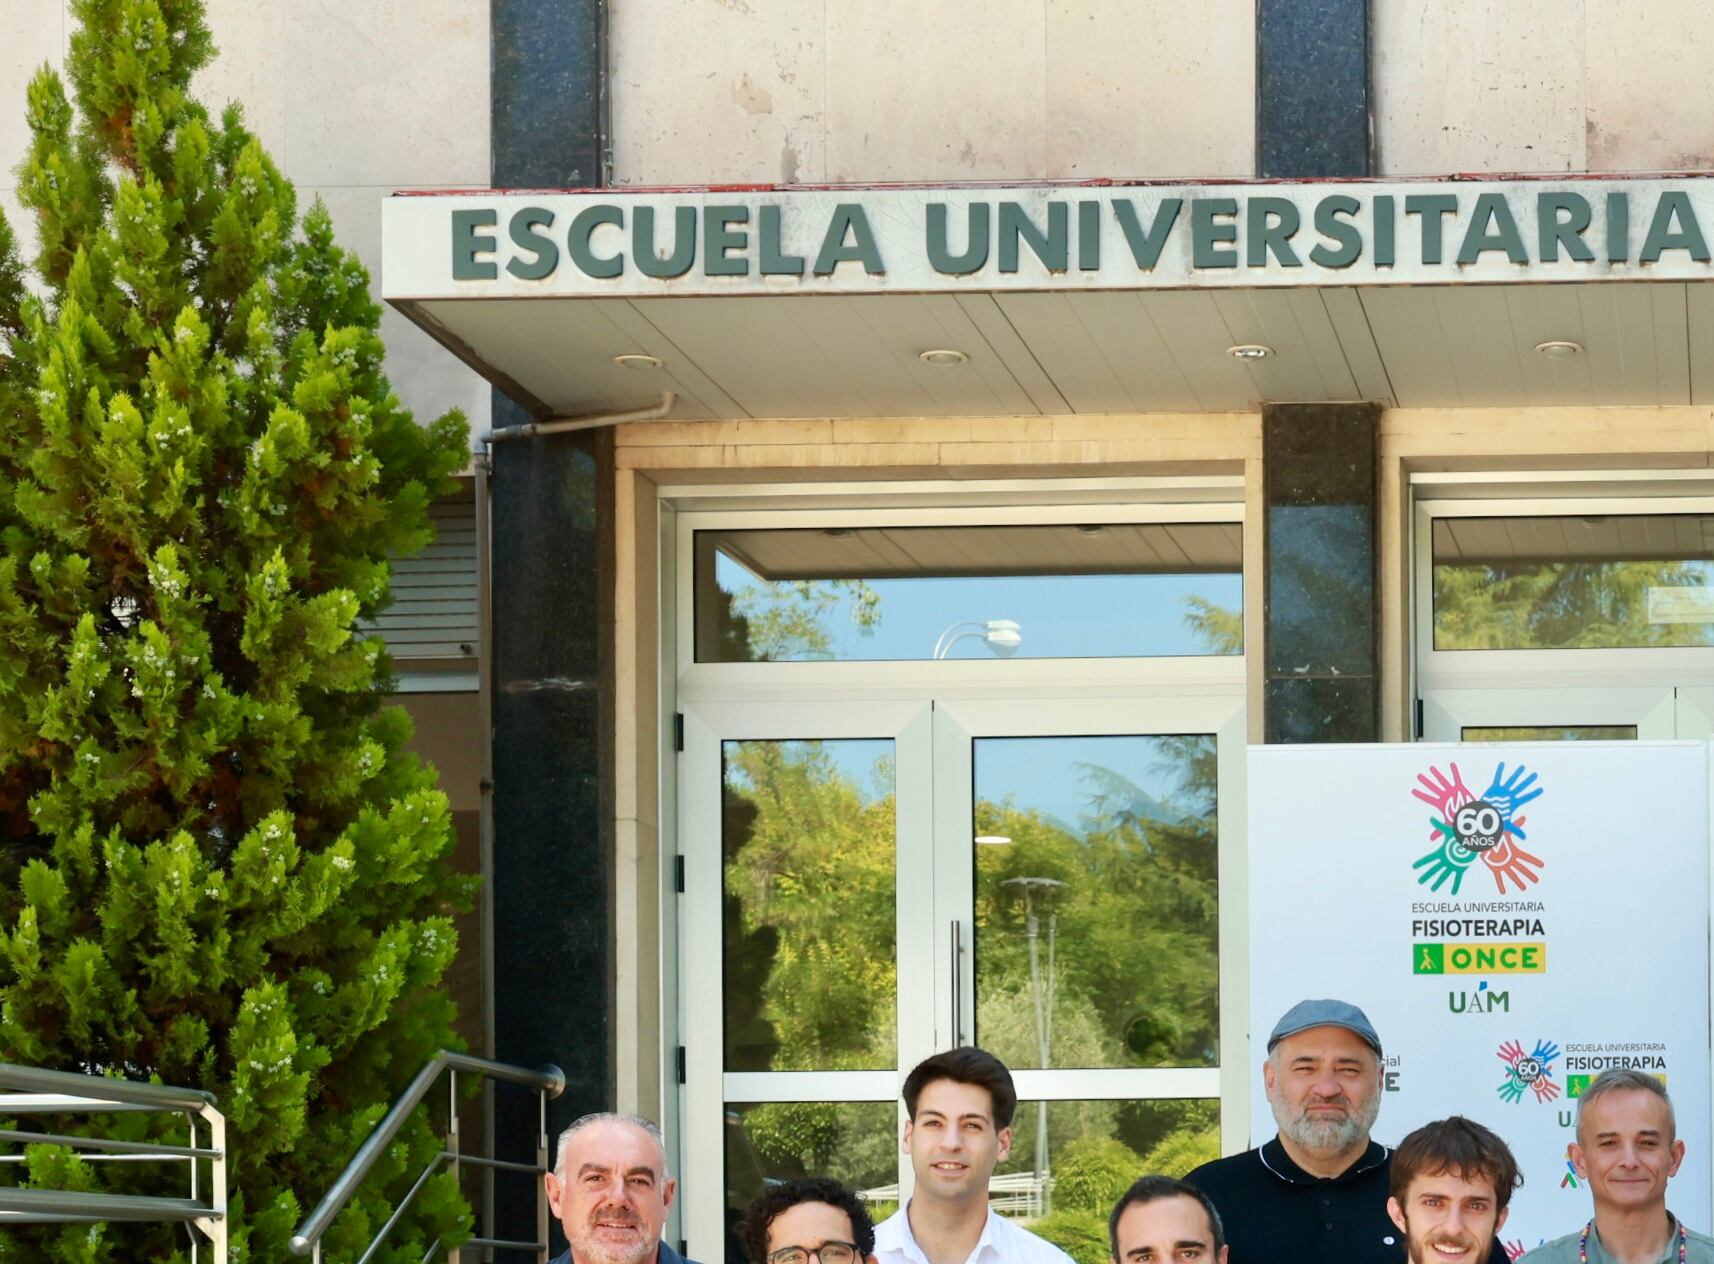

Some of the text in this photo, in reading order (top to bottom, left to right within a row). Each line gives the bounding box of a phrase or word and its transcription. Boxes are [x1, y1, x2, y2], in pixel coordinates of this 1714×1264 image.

[451, 203, 885, 281] ESCUELA
[926, 190, 1711, 276] UNIVERSITARIA
[1456, 808, 1500, 836] 60
[1462, 834, 1495, 846] AÑOS
[1411, 901, 1545, 914] ESCUELA UNIVERSITARIA
[1412, 919, 1545, 937] FISIOTERAPIA
[1451, 947, 1538, 969] ONCE
[1448, 989, 1510, 1013] UAM
[1565, 1042, 1667, 1052] ESCUELA UNIVERSITARIA
[1518, 1061, 1540, 1075] 60
[1566, 1056, 1667, 1070] FISIOTERAPIA
